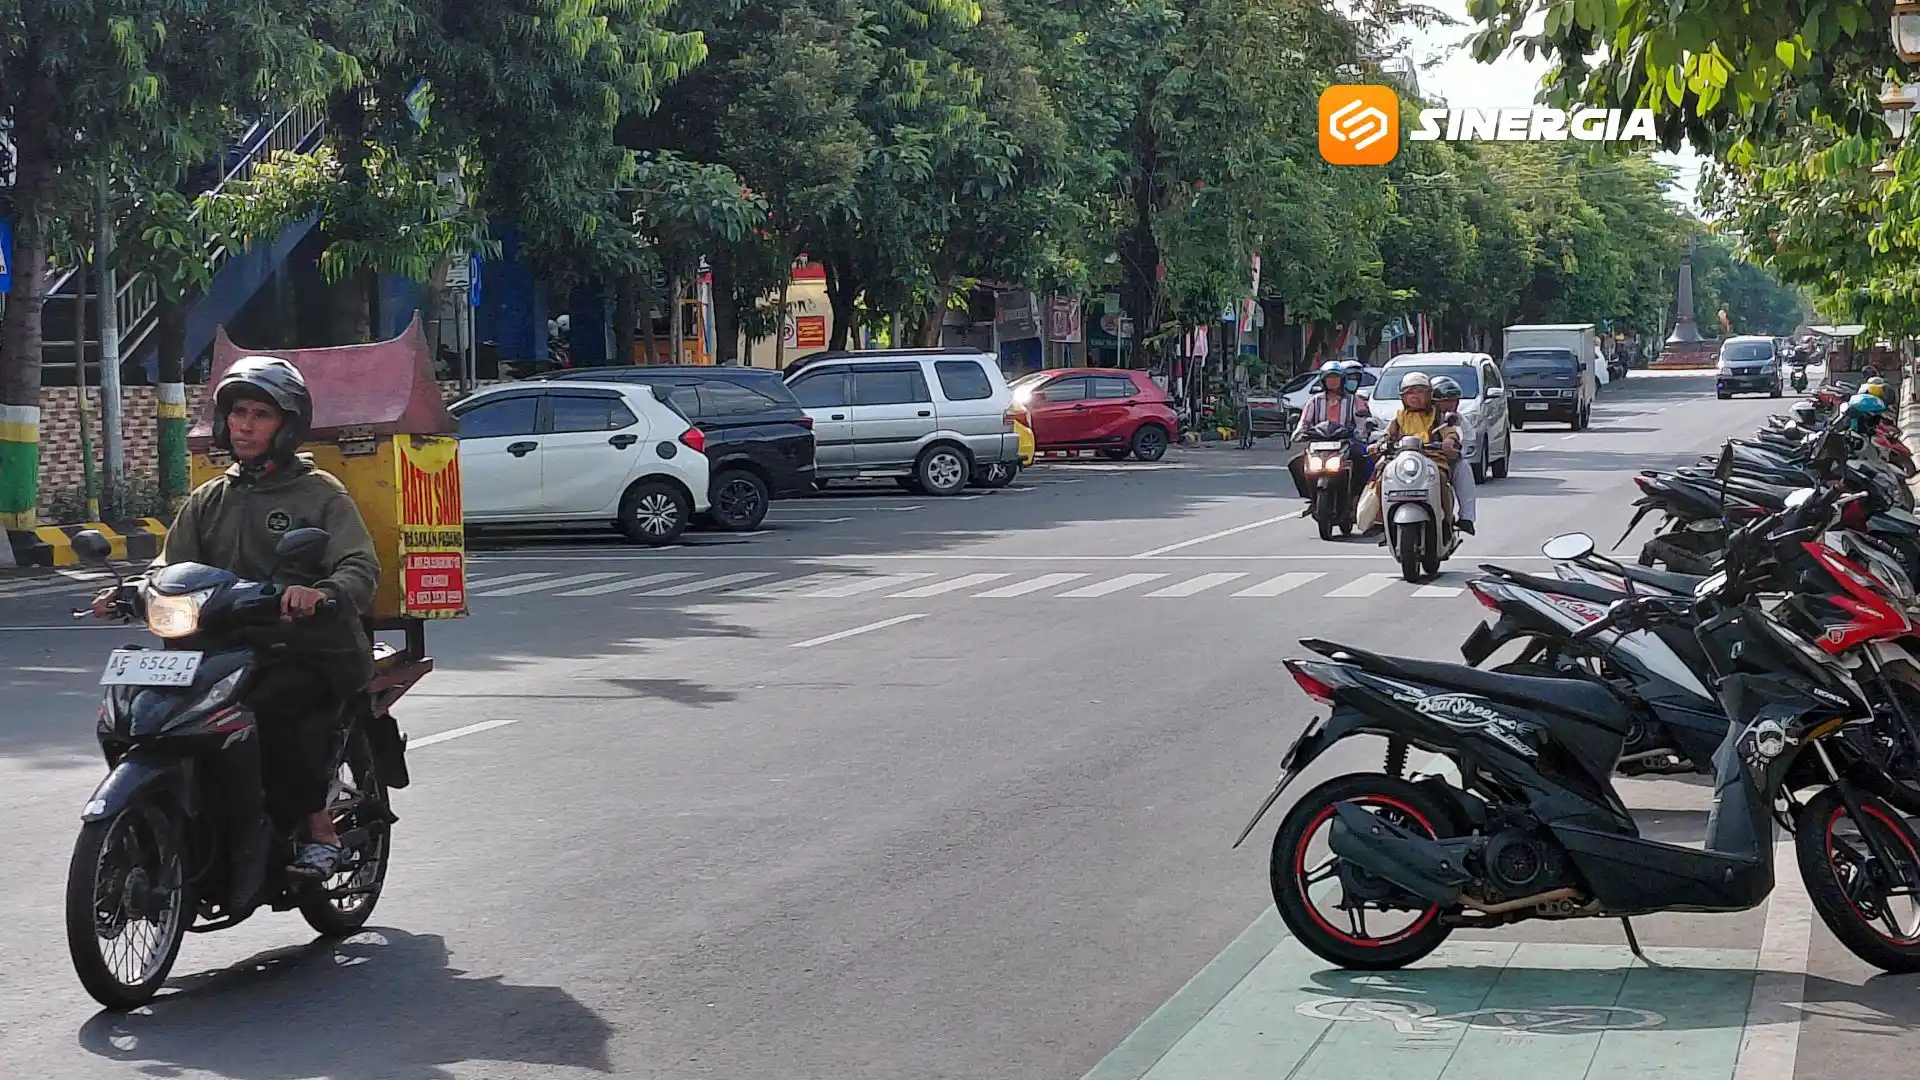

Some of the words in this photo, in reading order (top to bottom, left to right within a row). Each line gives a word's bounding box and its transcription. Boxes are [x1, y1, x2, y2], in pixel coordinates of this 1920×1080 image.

[400, 446, 433, 525] RATU
[433, 447, 462, 525] SARI
[186, 656, 197, 670] C
[1813, 687, 1850, 707] HONDA
